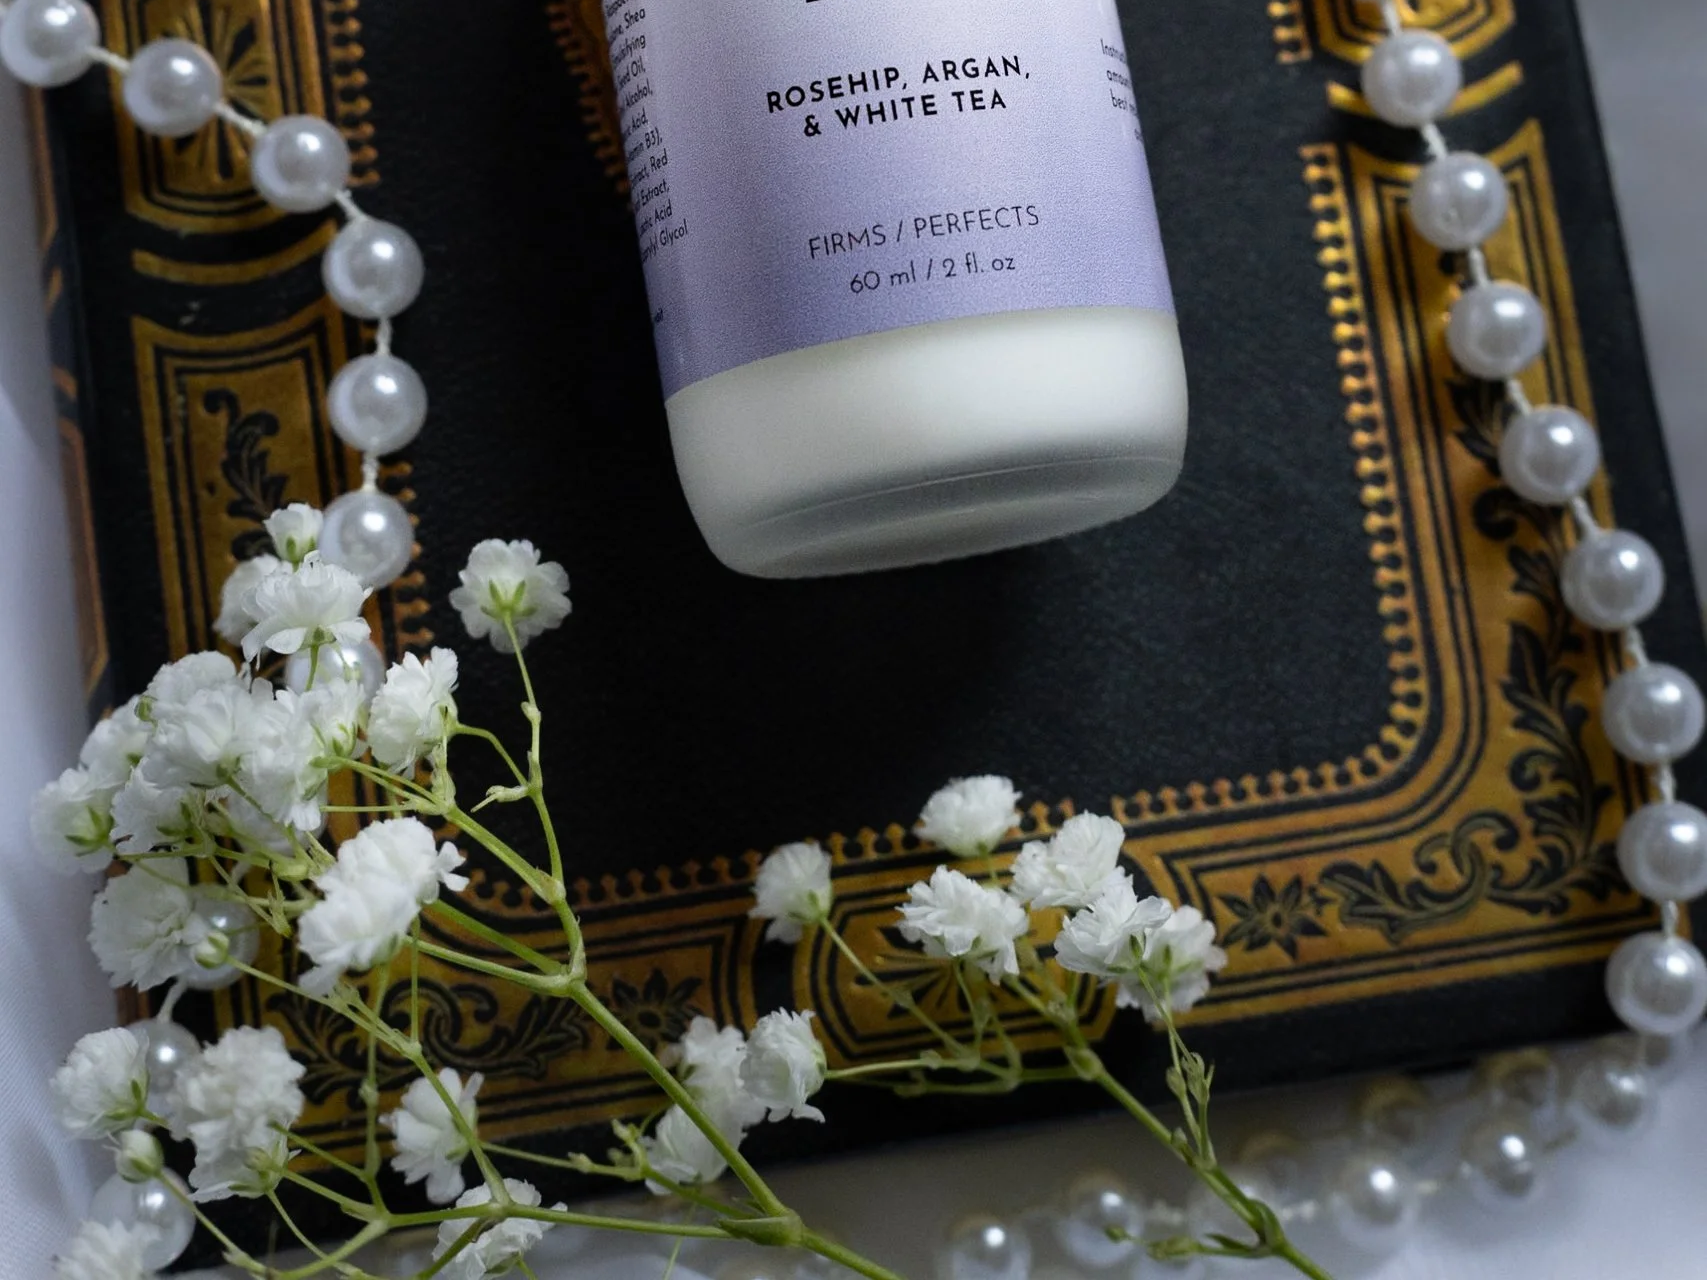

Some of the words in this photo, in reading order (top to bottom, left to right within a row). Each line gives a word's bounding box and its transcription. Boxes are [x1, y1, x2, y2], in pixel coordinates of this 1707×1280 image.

[624, 8, 646, 29] Shea
[631, 55, 646, 77] Oil,
[625, 77, 653, 108] Alcohol,
[766, 67, 908, 113] ROSEHIP,
[922, 55, 1031, 84] ARGAN,
[803, 114, 822, 137] &
[835, 94, 938, 129] WHITE
[951, 88, 1007, 112] TEA
[650, 148, 668, 172] Red
[640, 178, 670, 207] Extract,
[654, 198, 672, 224] Acid
[659, 218, 688, 246] Glycol
[808, 224, 887, 260] FIRMS
[896, 219, 904, 243] /
[914, 205, 1040, 239] PERFECTS
[850, 270, 881, 294] 60
[890, 260, 917, 286] ml
[926, 257, 934, 281] /
[942, 258, 958, 279] 2
[965, 251, 985, 274] fl.
[991, 256, 1016, 272] oz
